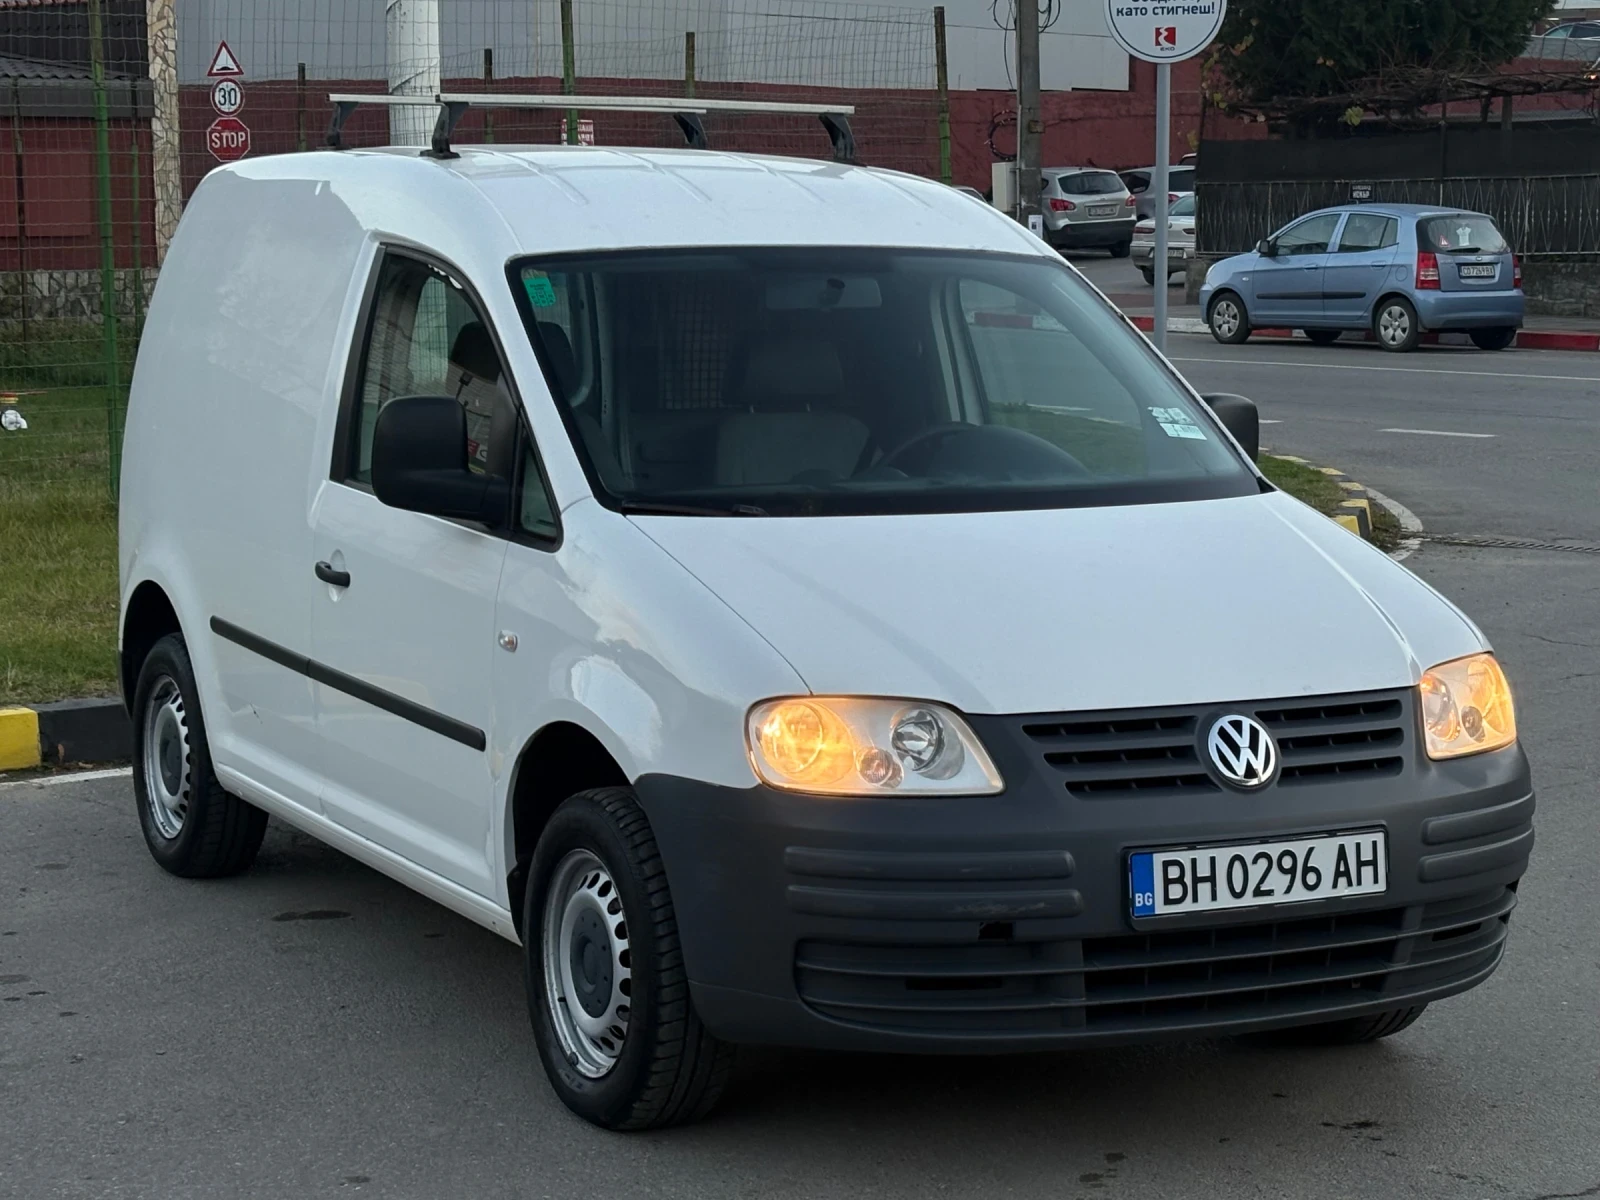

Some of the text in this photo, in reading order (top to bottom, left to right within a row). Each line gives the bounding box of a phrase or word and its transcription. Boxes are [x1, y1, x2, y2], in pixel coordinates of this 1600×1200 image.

[1116, 2, 1215, 17] като стигнеш!
[218, 87, 237, 106] 30
[211, 132, 246, 148] STOP
[1162, 840, 1379, 906] BH 0296 AH
[1135, 892, 1153, 907] BG
